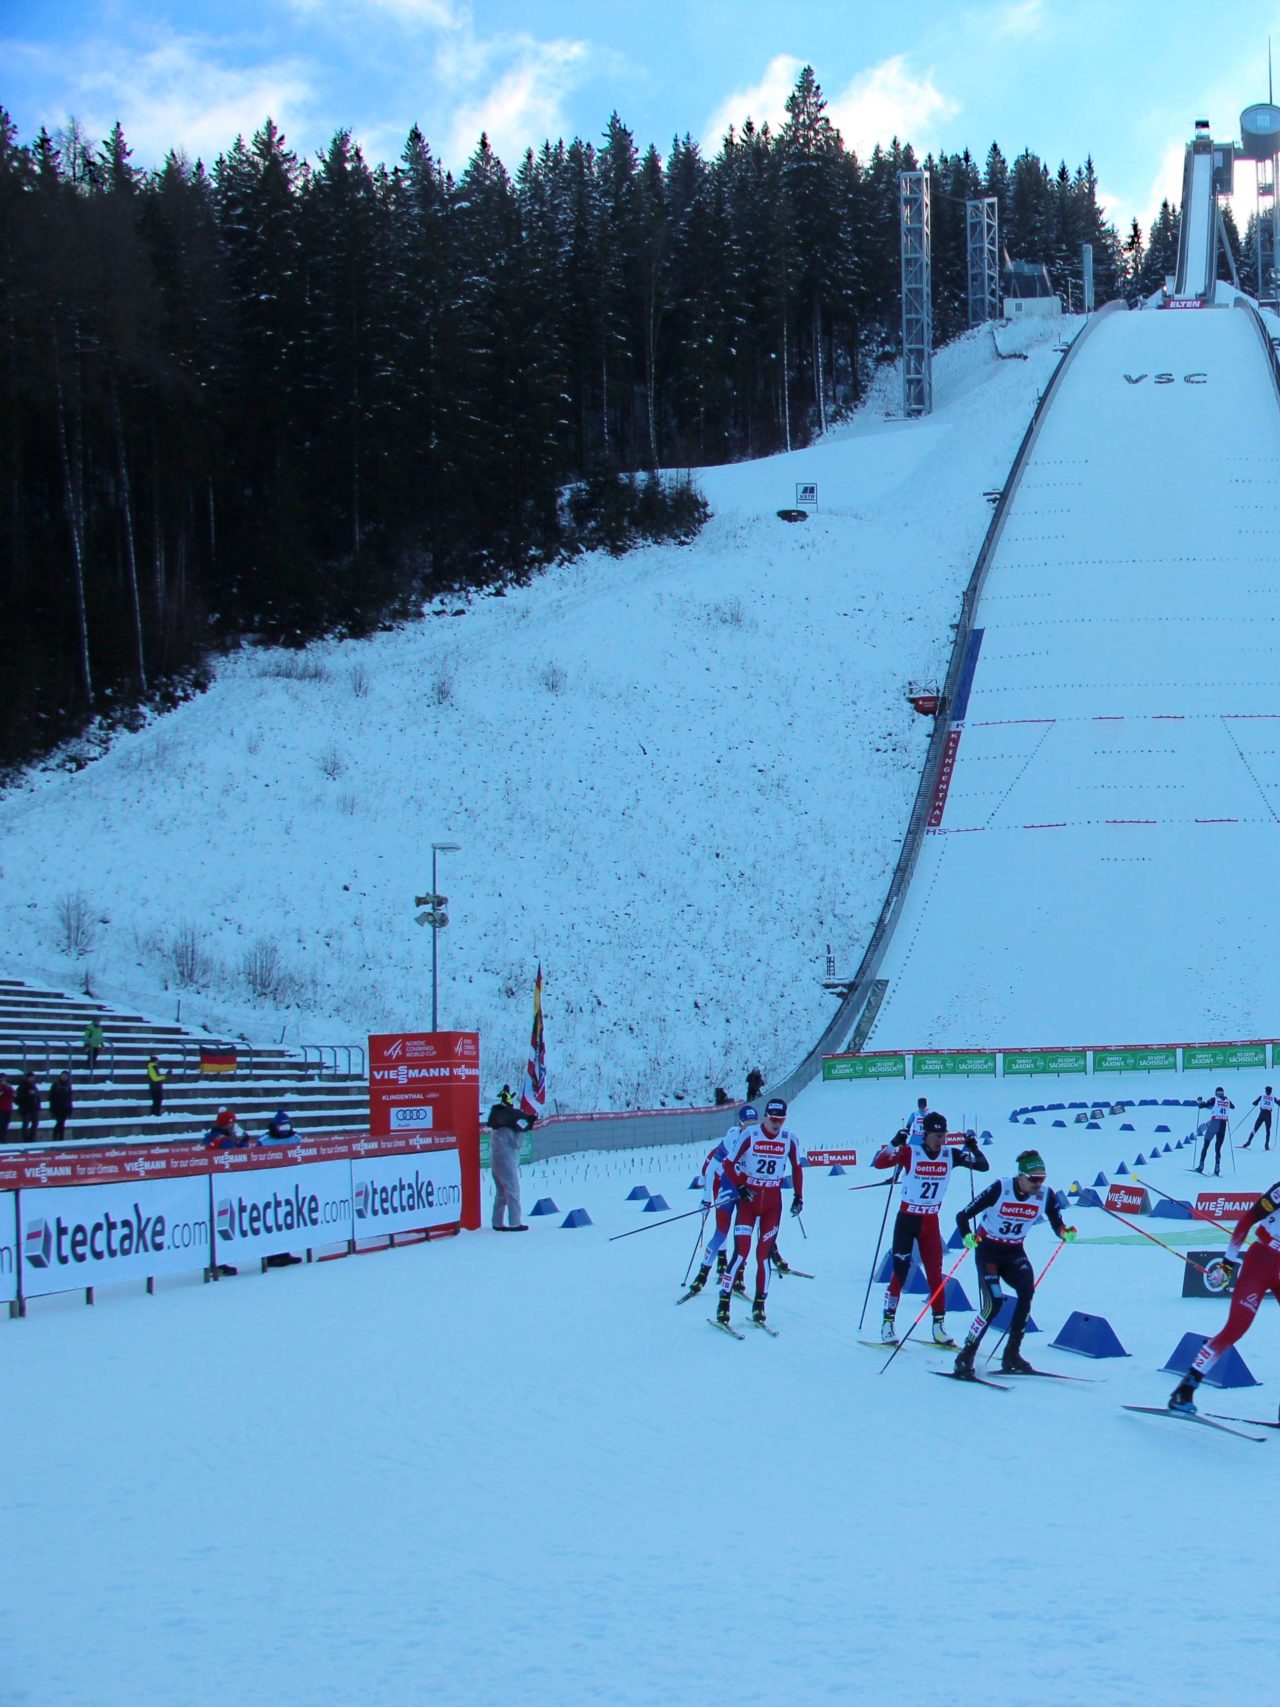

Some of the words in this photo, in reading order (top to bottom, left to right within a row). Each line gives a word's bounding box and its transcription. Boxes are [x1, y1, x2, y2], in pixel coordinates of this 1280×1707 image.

[1170, 300, 1201, 308] ELTEN
[1123, 373, 1208, 385] VSC
[931, 733, 958, 824] KLINGENTHAL
[373, 1066, 450, 1084] VIESSMANN
[754, 1143, 784, 1152] bett1.de
[808, 1153, 855, 1164] VIESSMANN
[24, 1163, 71, 1183] VIESSMANN
[124, 1157, 166, 1176] VIESSMANN
[756, 1159, 776, 1175] 28
[746, 1177, 780, 1188] ELTEN
[920, 1182, 939, 1199] 27
[370, 1170, 460, 1217] tectake.com
[1108, 1190, 1142, 1208] VIESSMANN
[238, 1183, 350, 1238] tectake.com
[1001, 1206, 1036, 1216] bett1.de
[56, 1202, 209, 1265] tectake.com
[999, 1221, 1024, 1235] 34
